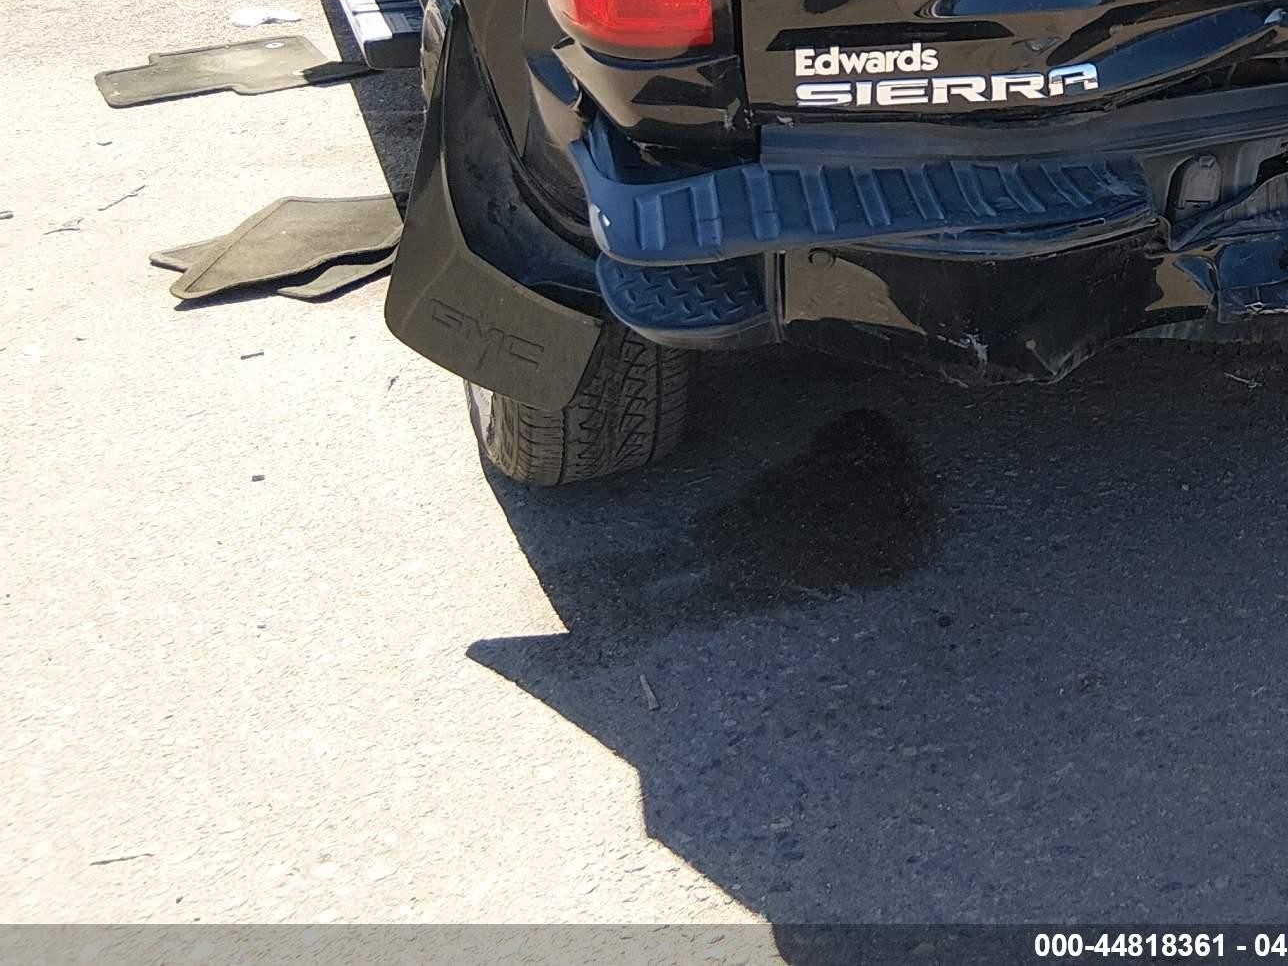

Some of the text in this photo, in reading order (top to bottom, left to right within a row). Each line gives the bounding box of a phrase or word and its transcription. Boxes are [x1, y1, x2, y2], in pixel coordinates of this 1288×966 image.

[795, 42, 938, 76] Edwards
[795, 62, 1099, 107] SIERRA
[429, 298, 545, 372] GMC
